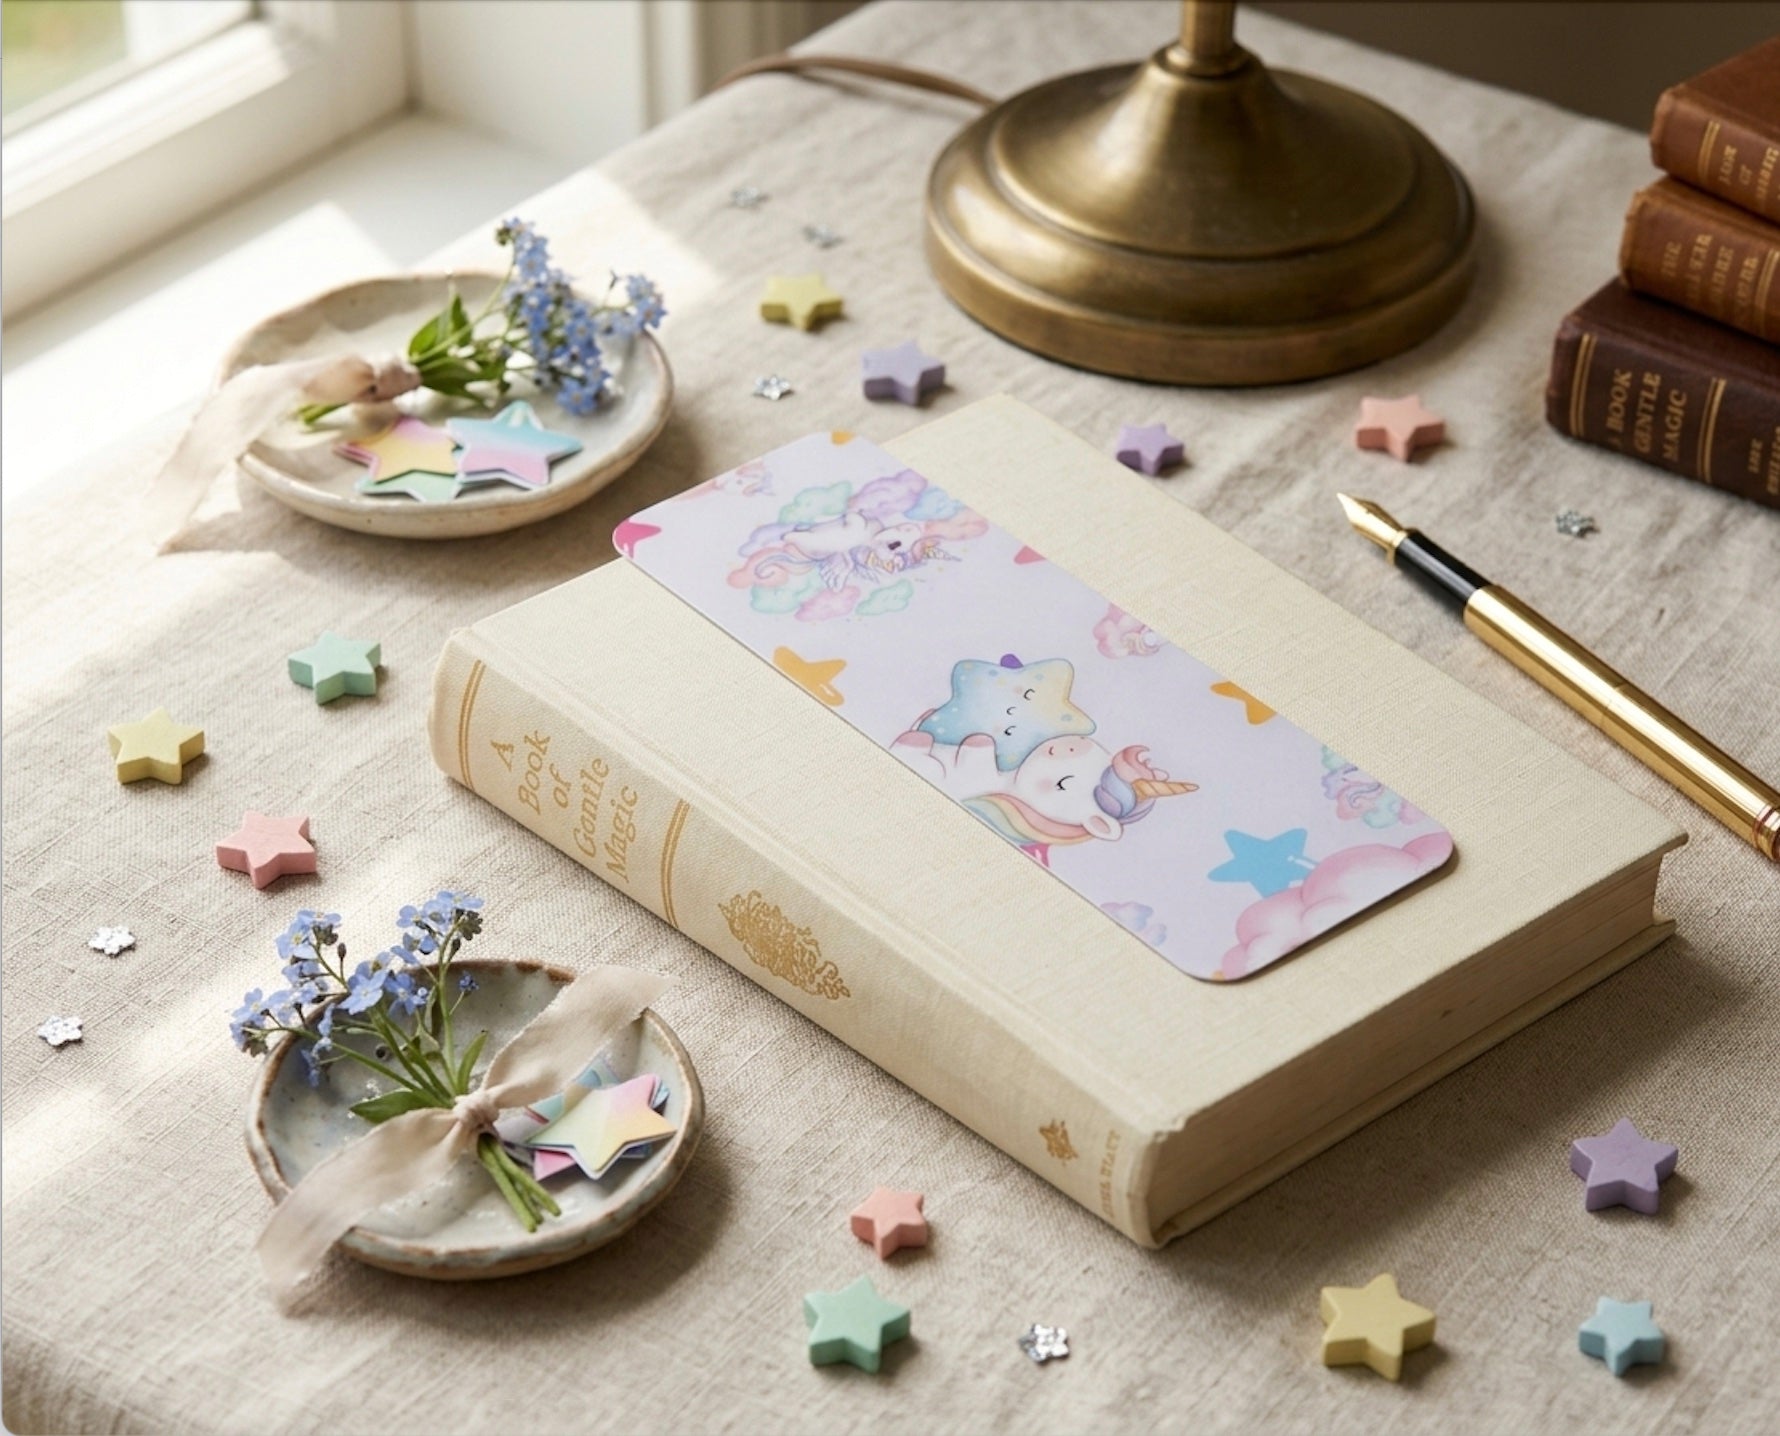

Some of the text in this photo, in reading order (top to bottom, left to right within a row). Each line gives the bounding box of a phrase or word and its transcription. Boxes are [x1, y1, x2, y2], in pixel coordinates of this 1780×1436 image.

[1606, 368, 1632, 433] BOOK
[1663, 389, 1687, 462] MAGIC
[490, 739, 514, 772] A
[518, 730, 550, 816] Book
[549, 763, 571, 809] of
[603, 785, 638, 884] Magic
